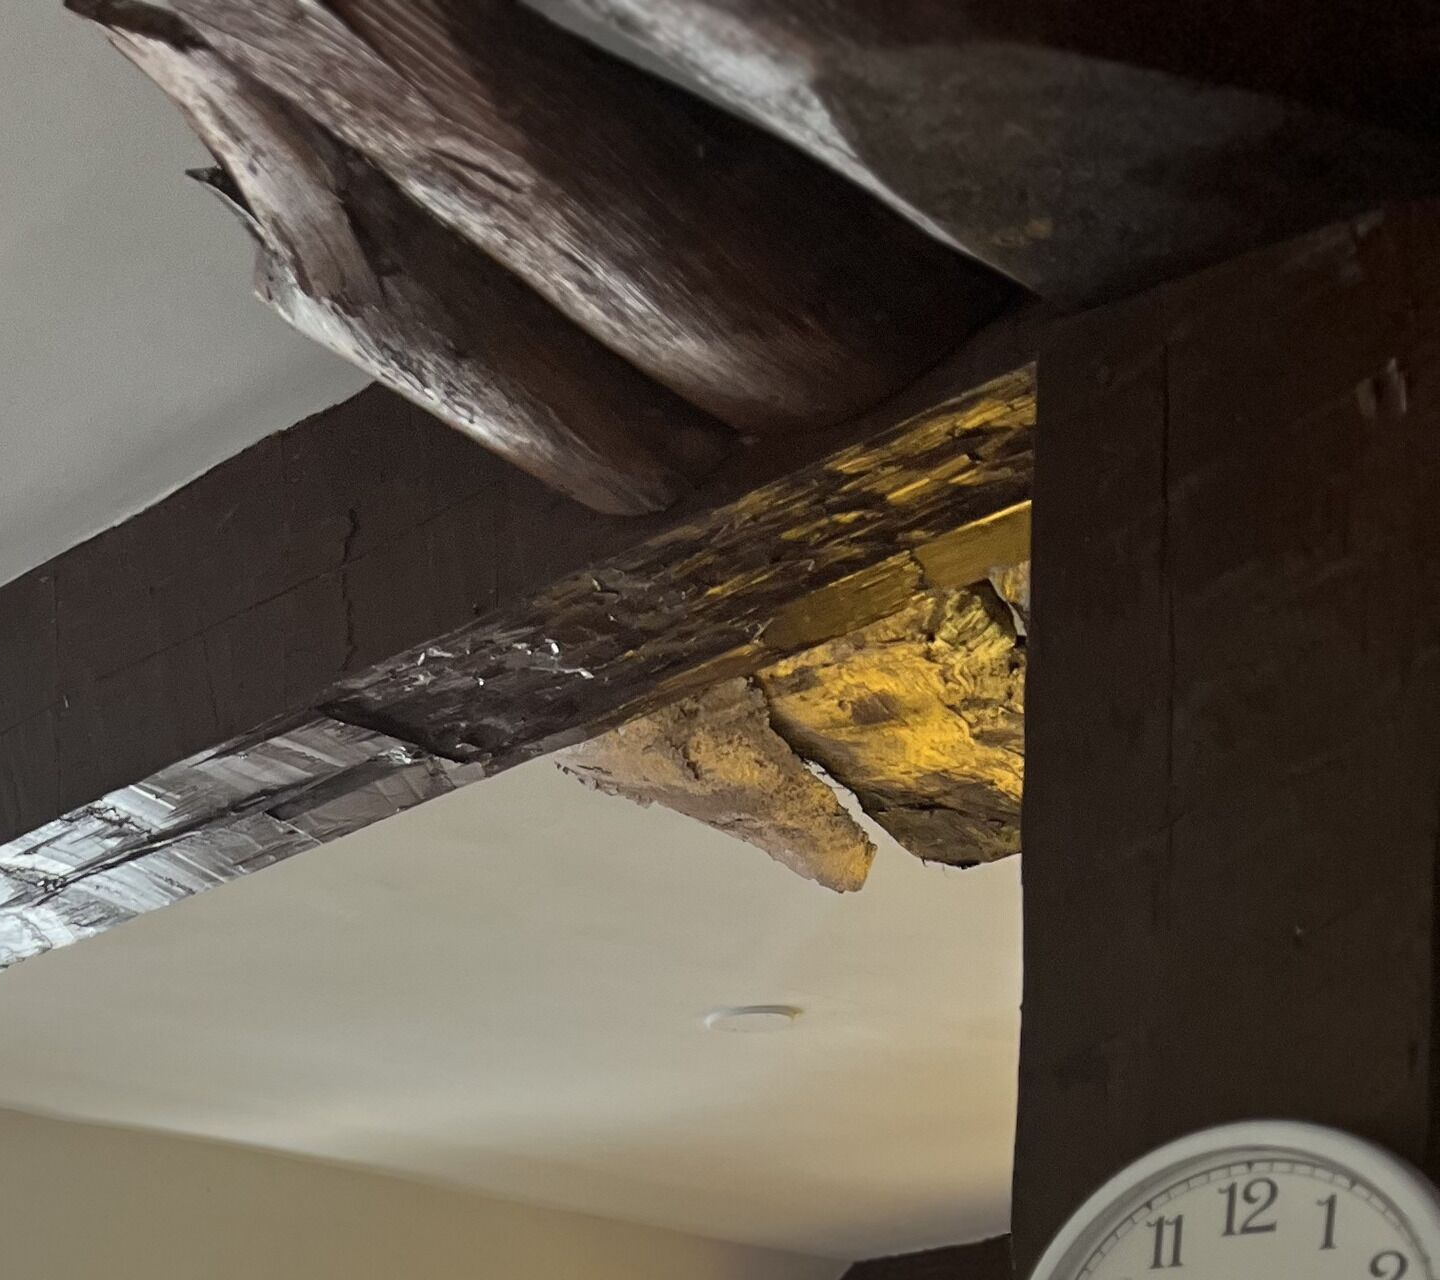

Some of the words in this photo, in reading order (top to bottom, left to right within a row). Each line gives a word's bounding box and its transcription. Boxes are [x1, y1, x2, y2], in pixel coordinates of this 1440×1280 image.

[1218, 1177, 1279, 1237] 12
[1318, 1193, 1338, 1250] 1
[1146, 1214, 1185, 1270] 11
